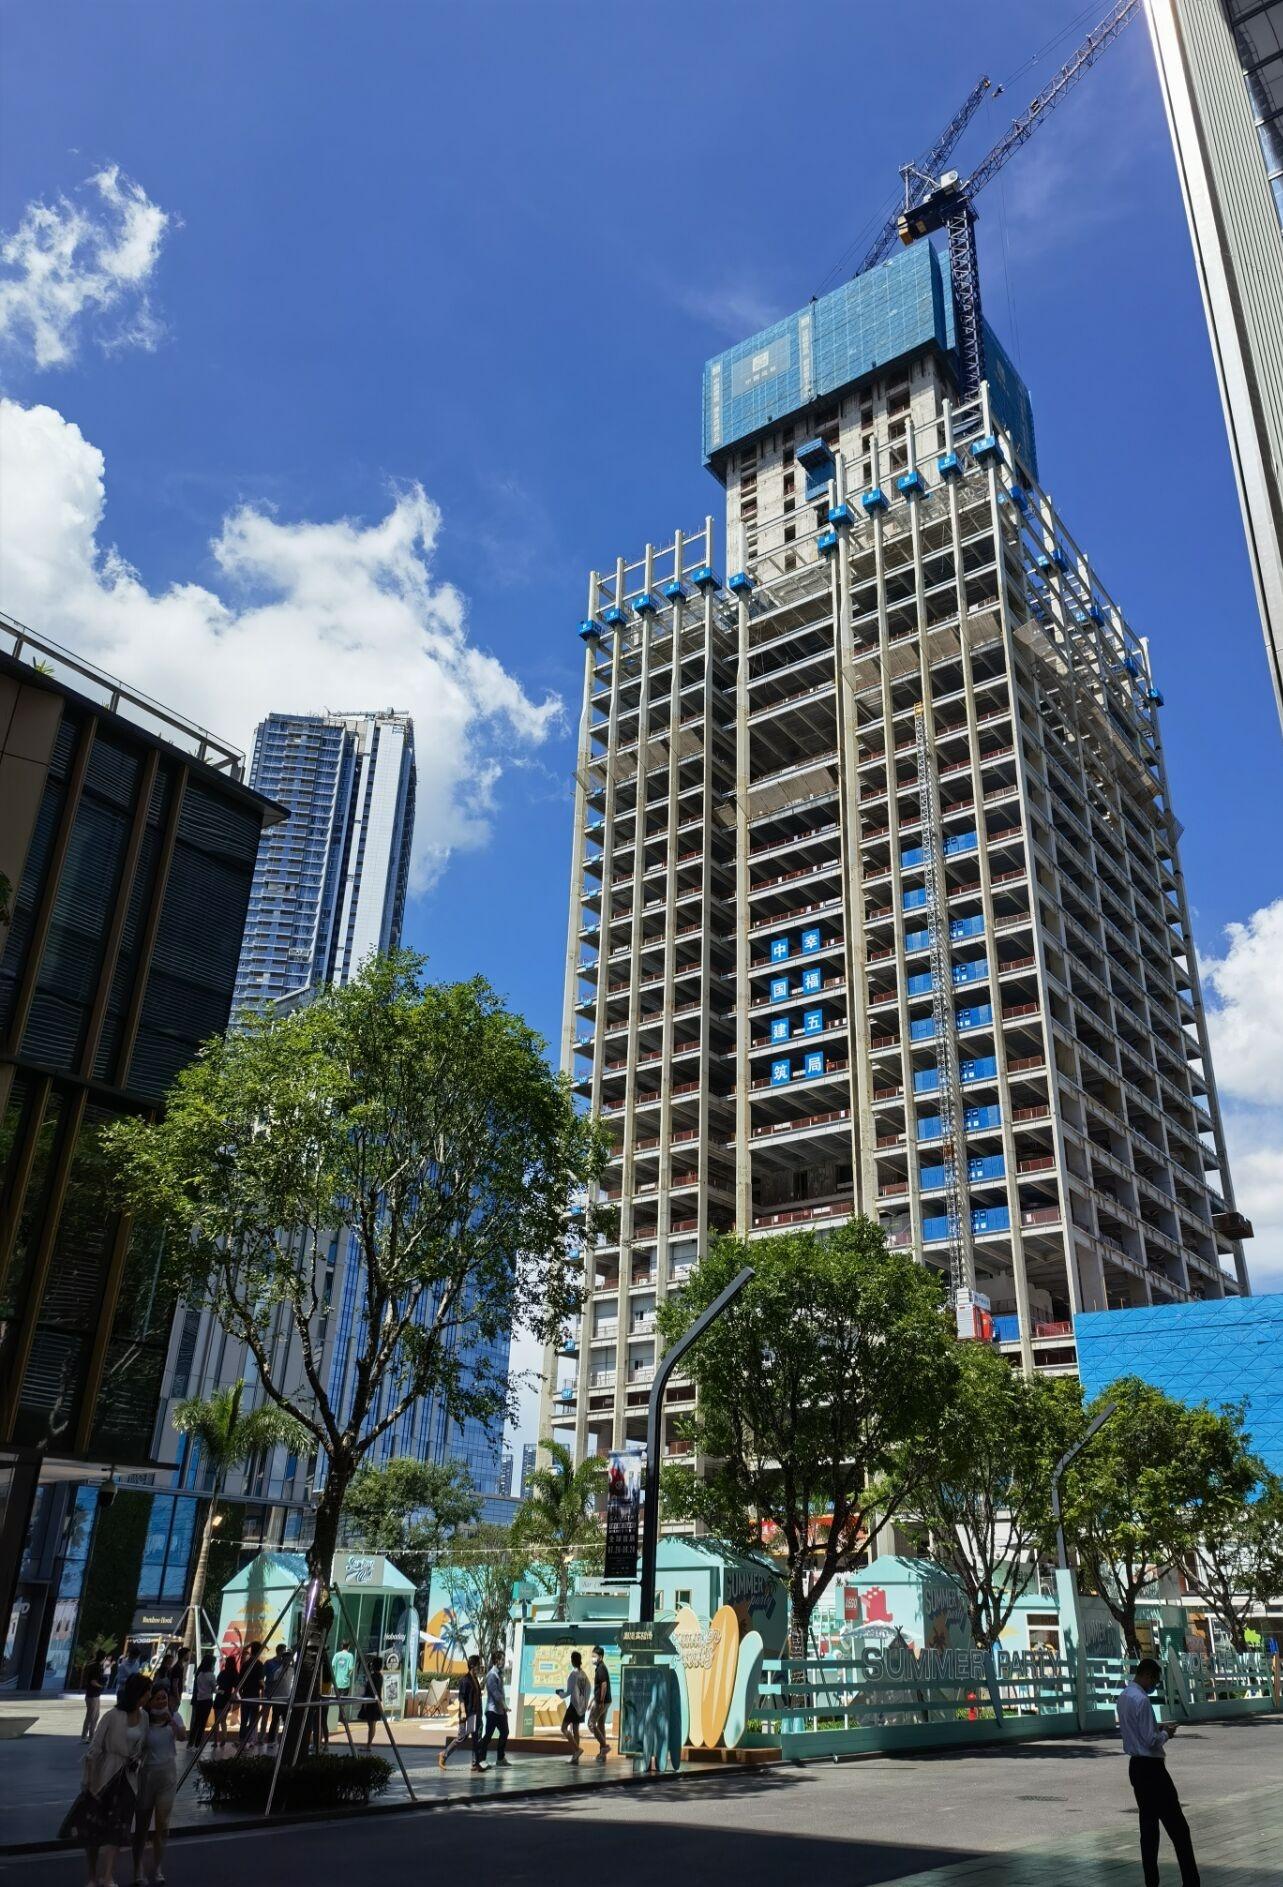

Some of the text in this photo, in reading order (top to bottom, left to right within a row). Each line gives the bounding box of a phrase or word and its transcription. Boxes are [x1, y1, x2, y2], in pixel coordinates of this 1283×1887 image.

[727, 1571, 763, 1600] SUMMER
[925, 1588, 958, 1614] SUMMER
[862, 1647, 1062, 1681] SUMMER PARTY
